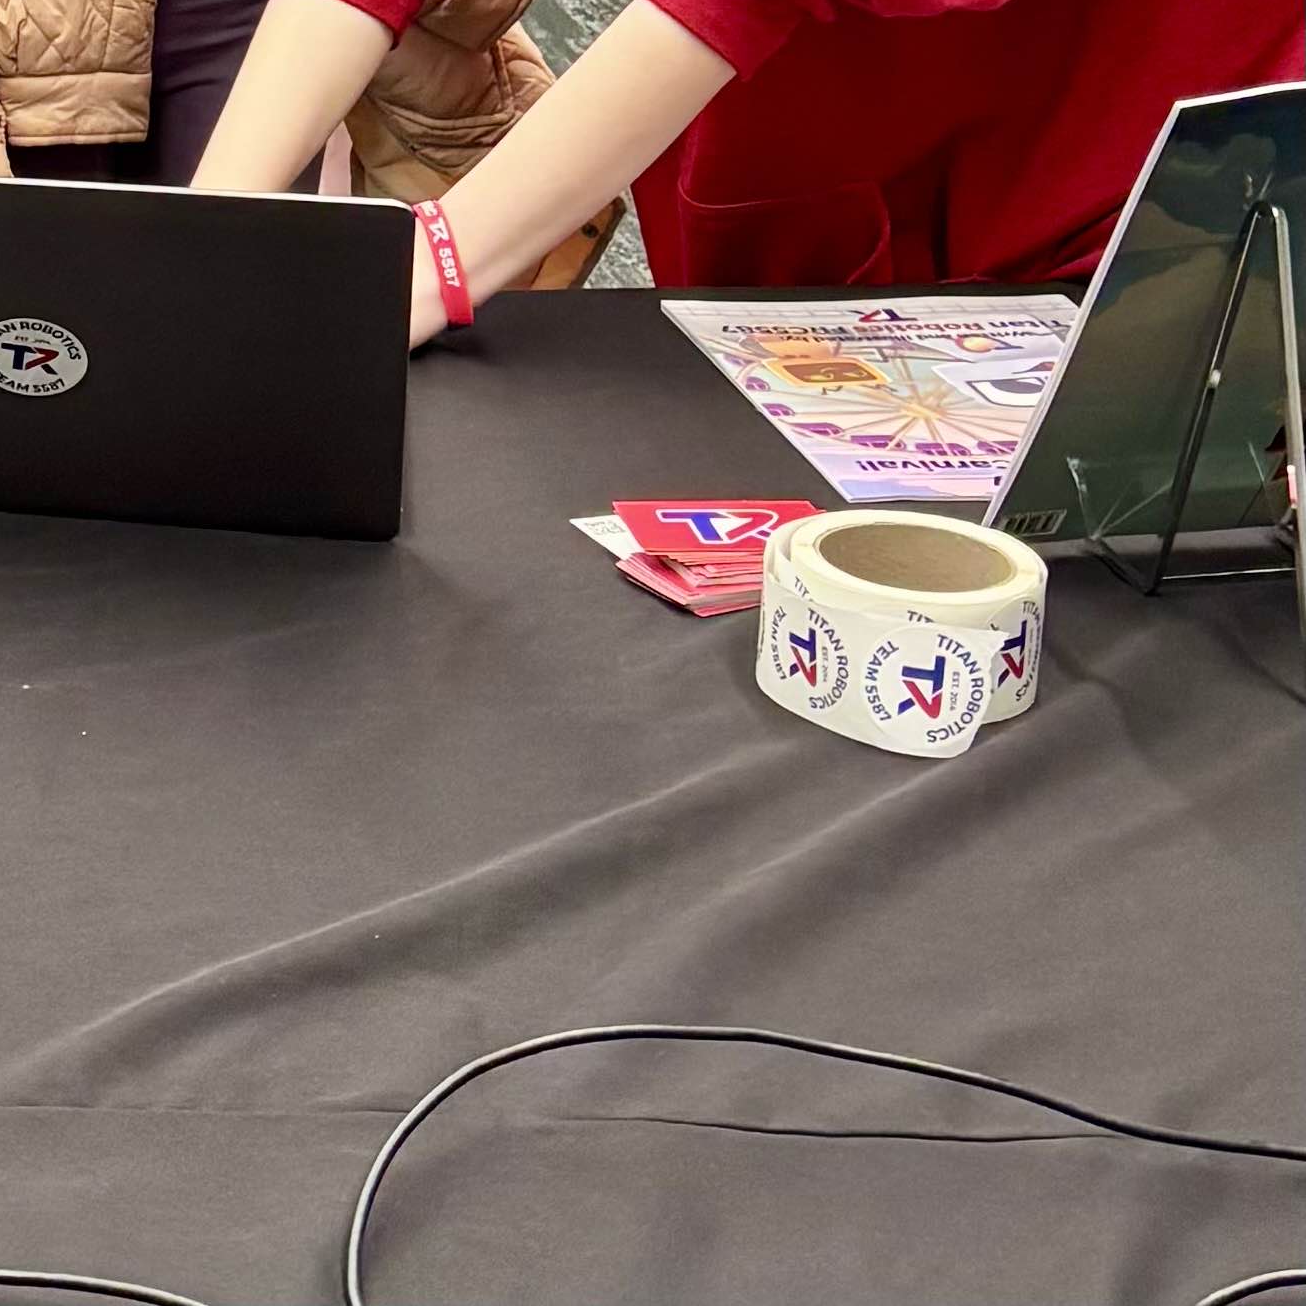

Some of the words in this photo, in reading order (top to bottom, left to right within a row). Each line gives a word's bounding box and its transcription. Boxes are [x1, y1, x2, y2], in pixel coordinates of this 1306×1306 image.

[19, 321, 82, 361] ROBOTICS
[32, 378, 66, 393] 5587
[808, 608, 844, 651] TITAN
[865, 641, 899, 681] TEAM
[938, 634, 981, 675] TITAN
[809, 655, 849, 709] ROBOTICS
[865, 685, 892, 721] 5587
[926, 677, 984, 743] ROBOTICS
